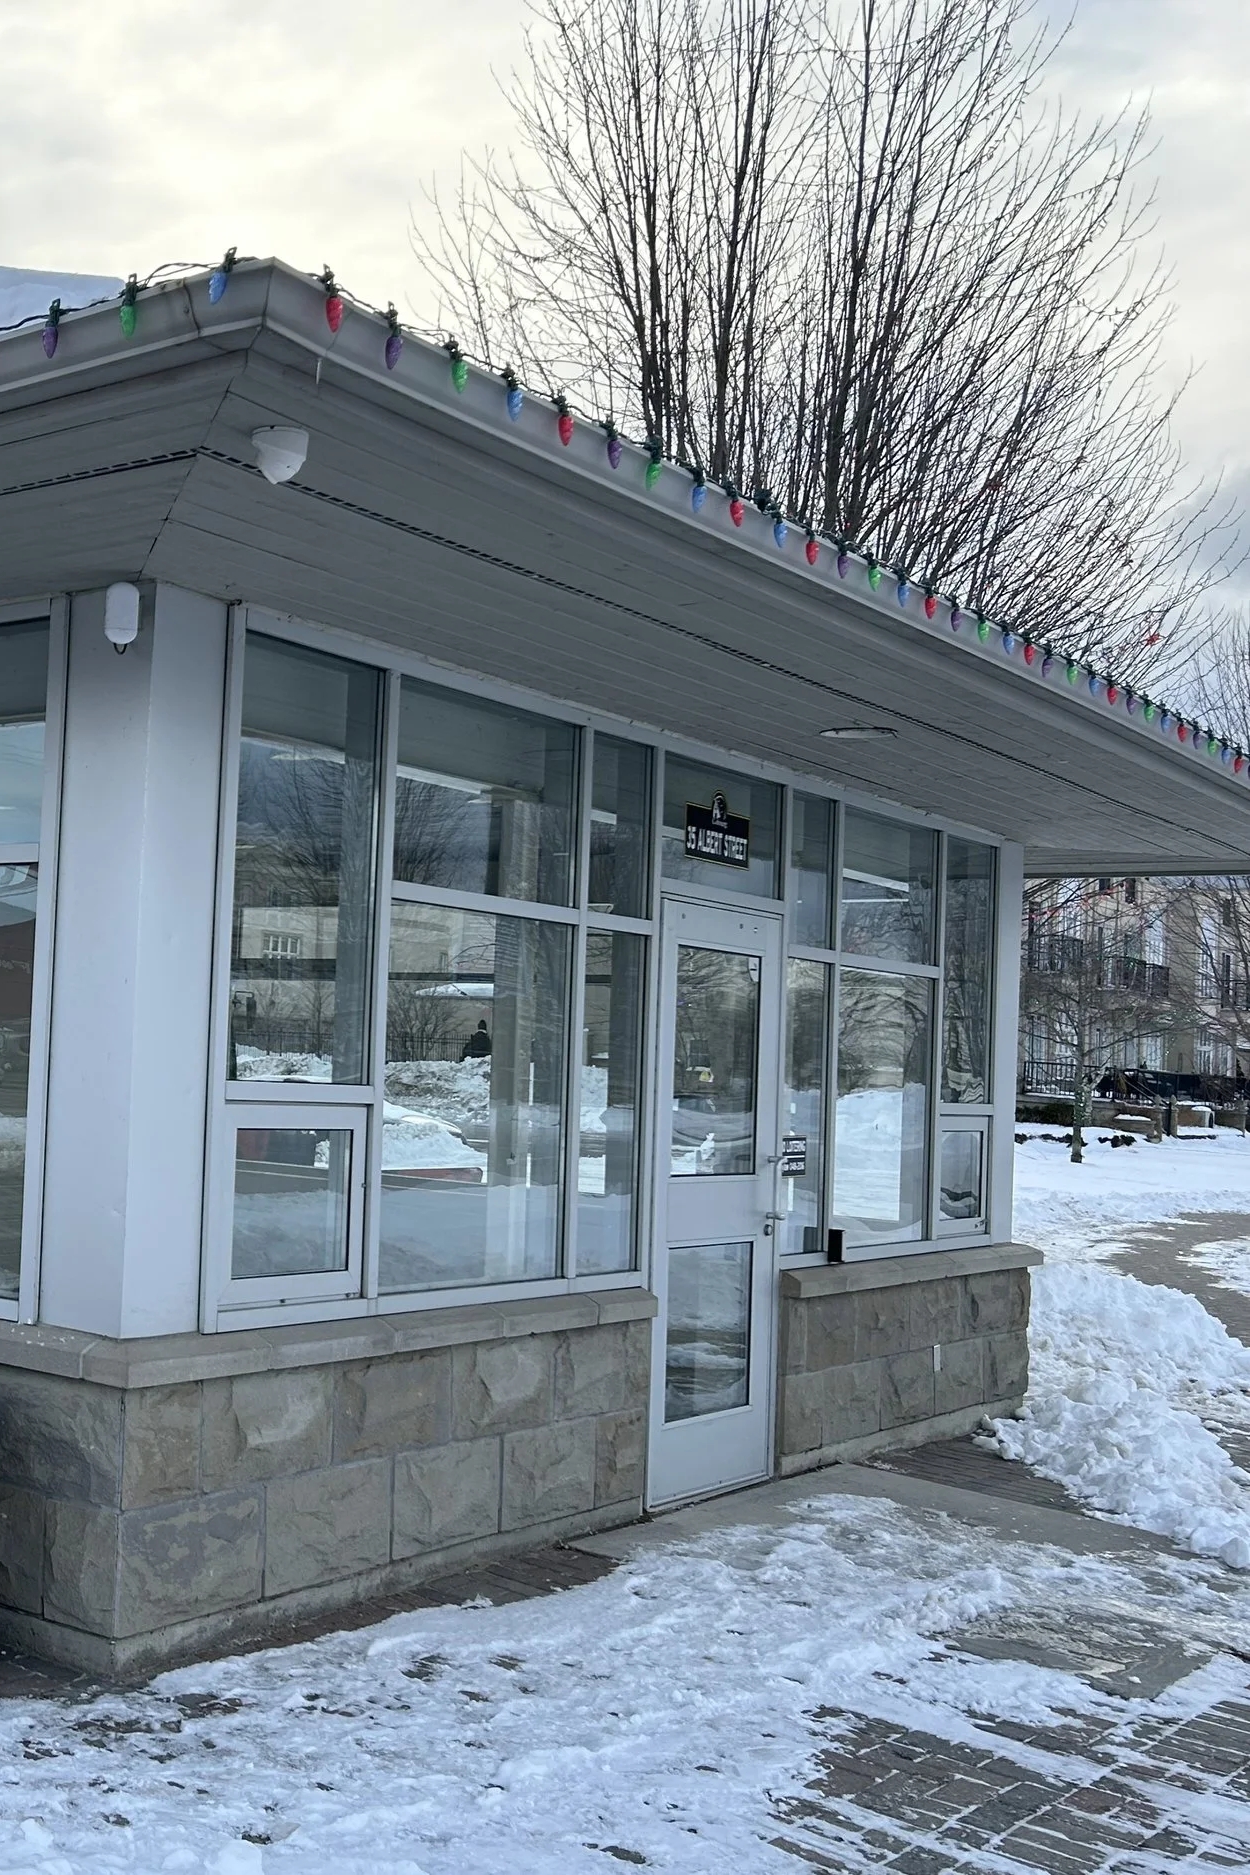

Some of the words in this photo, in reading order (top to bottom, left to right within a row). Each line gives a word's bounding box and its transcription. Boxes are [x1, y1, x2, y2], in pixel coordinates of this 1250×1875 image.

[686, 826, 696, 850] 35
[697, 828, 723, 856] ALBERT
[723, 834, 748, 861] STREET
